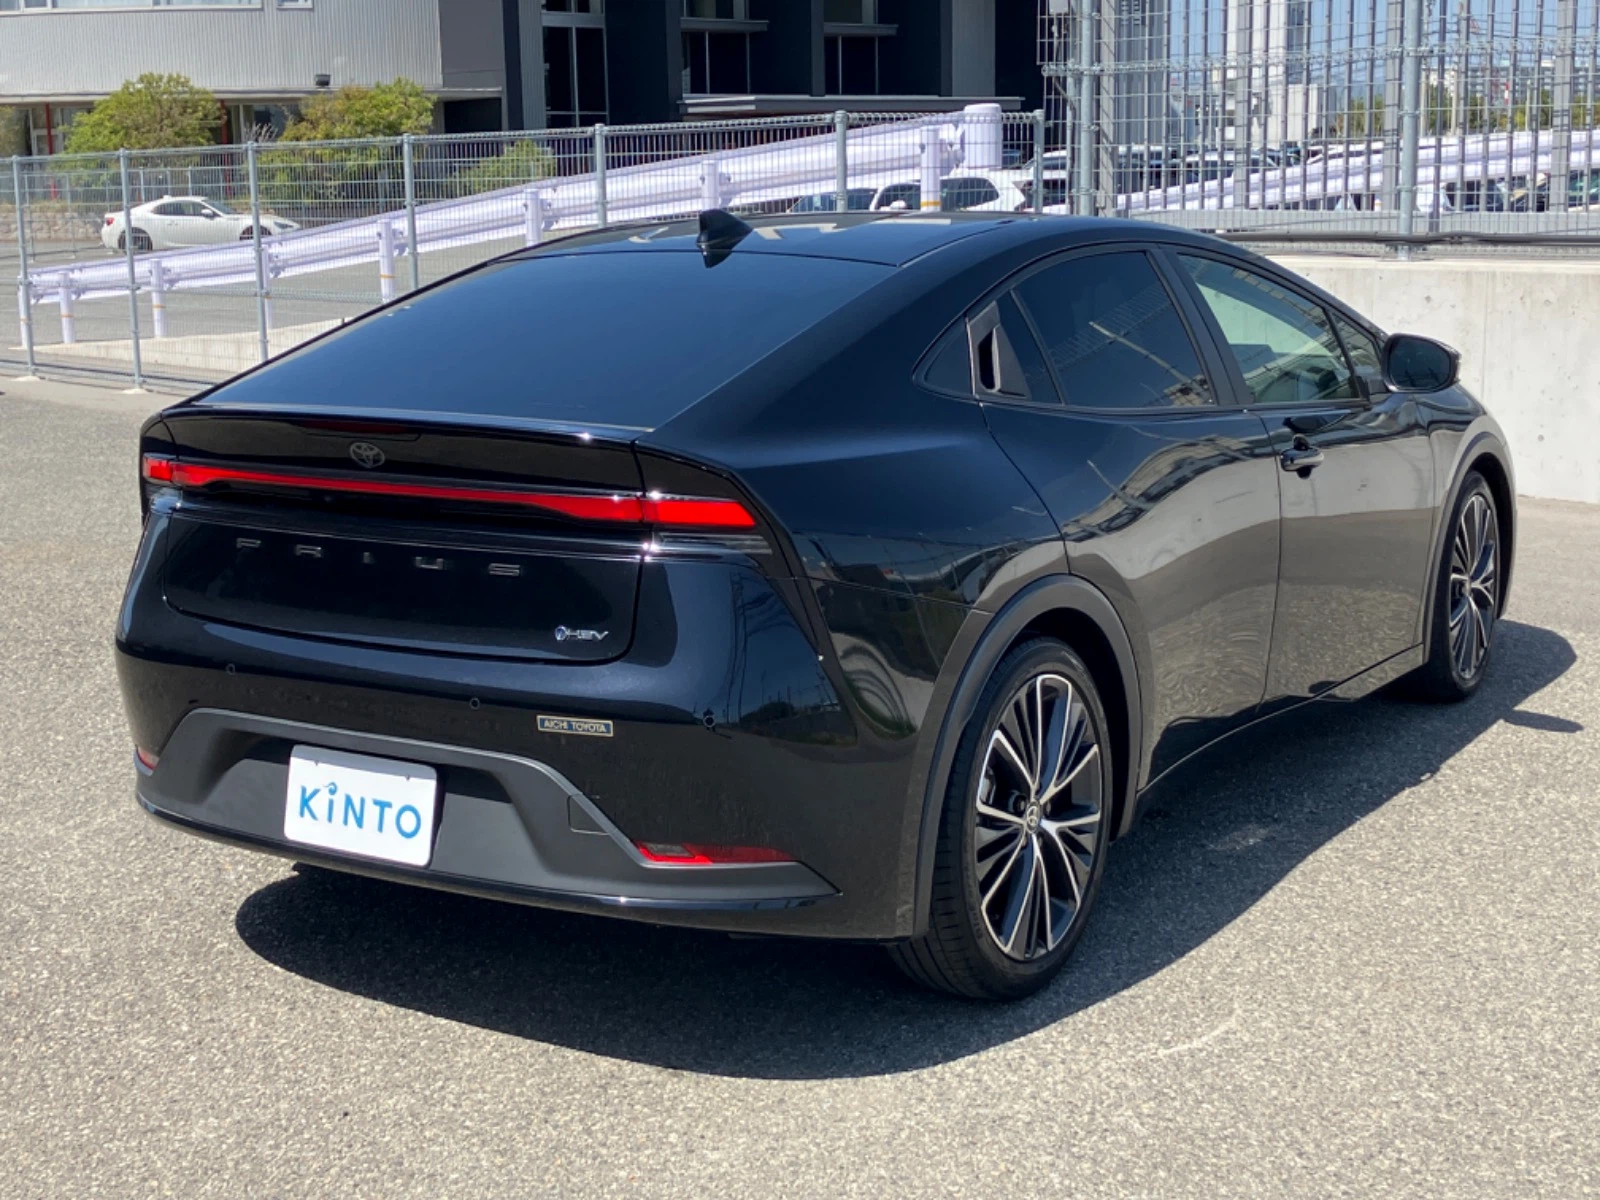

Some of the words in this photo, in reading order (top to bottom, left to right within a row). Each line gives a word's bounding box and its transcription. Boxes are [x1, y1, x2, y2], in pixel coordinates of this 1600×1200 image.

[236, 536, 522, 577] PRIUS
[543, 719, 568, 730] AICHI
[571, 721, 607, 733] TOYOTA
